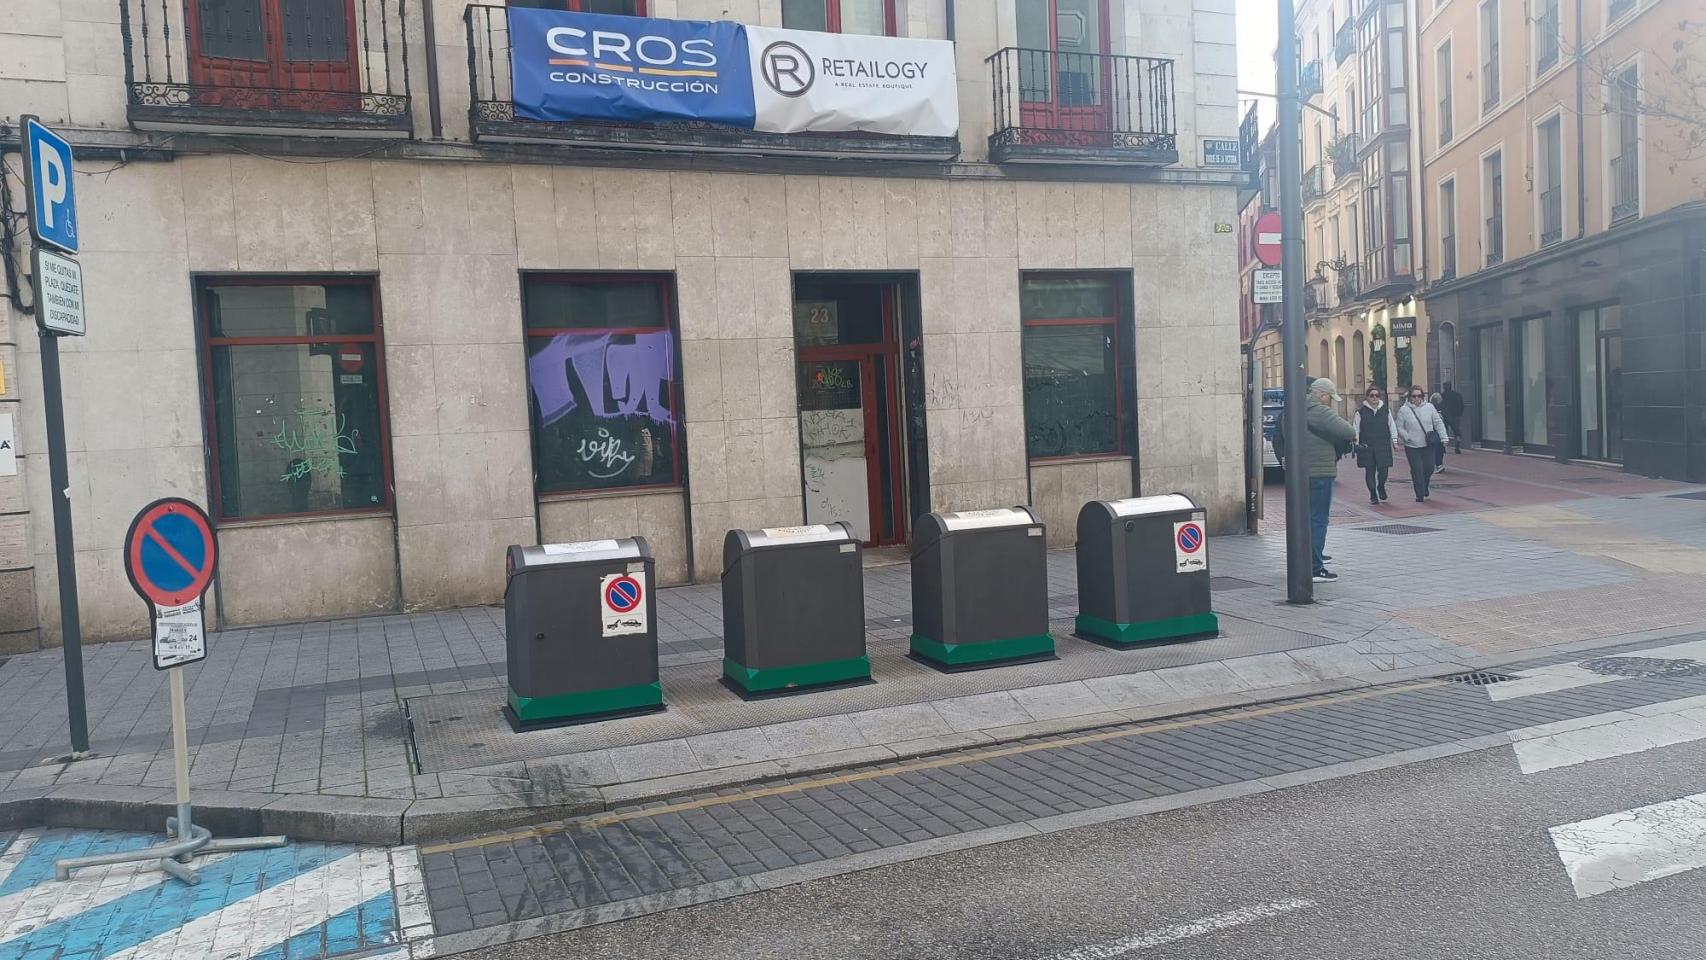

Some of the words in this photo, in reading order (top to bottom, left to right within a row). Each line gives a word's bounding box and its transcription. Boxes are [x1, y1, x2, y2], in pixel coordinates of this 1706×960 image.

[546, 26, 717, 67] CROS
[822, 57, 928, 79] RETAILOGY
[549, 71, 718, 94] CONSTRUCCIÓN
[1215, 141, 1238, 151] CALLE
[39, 139, 66, 229] P
[810, 307, 830, 324] 23
